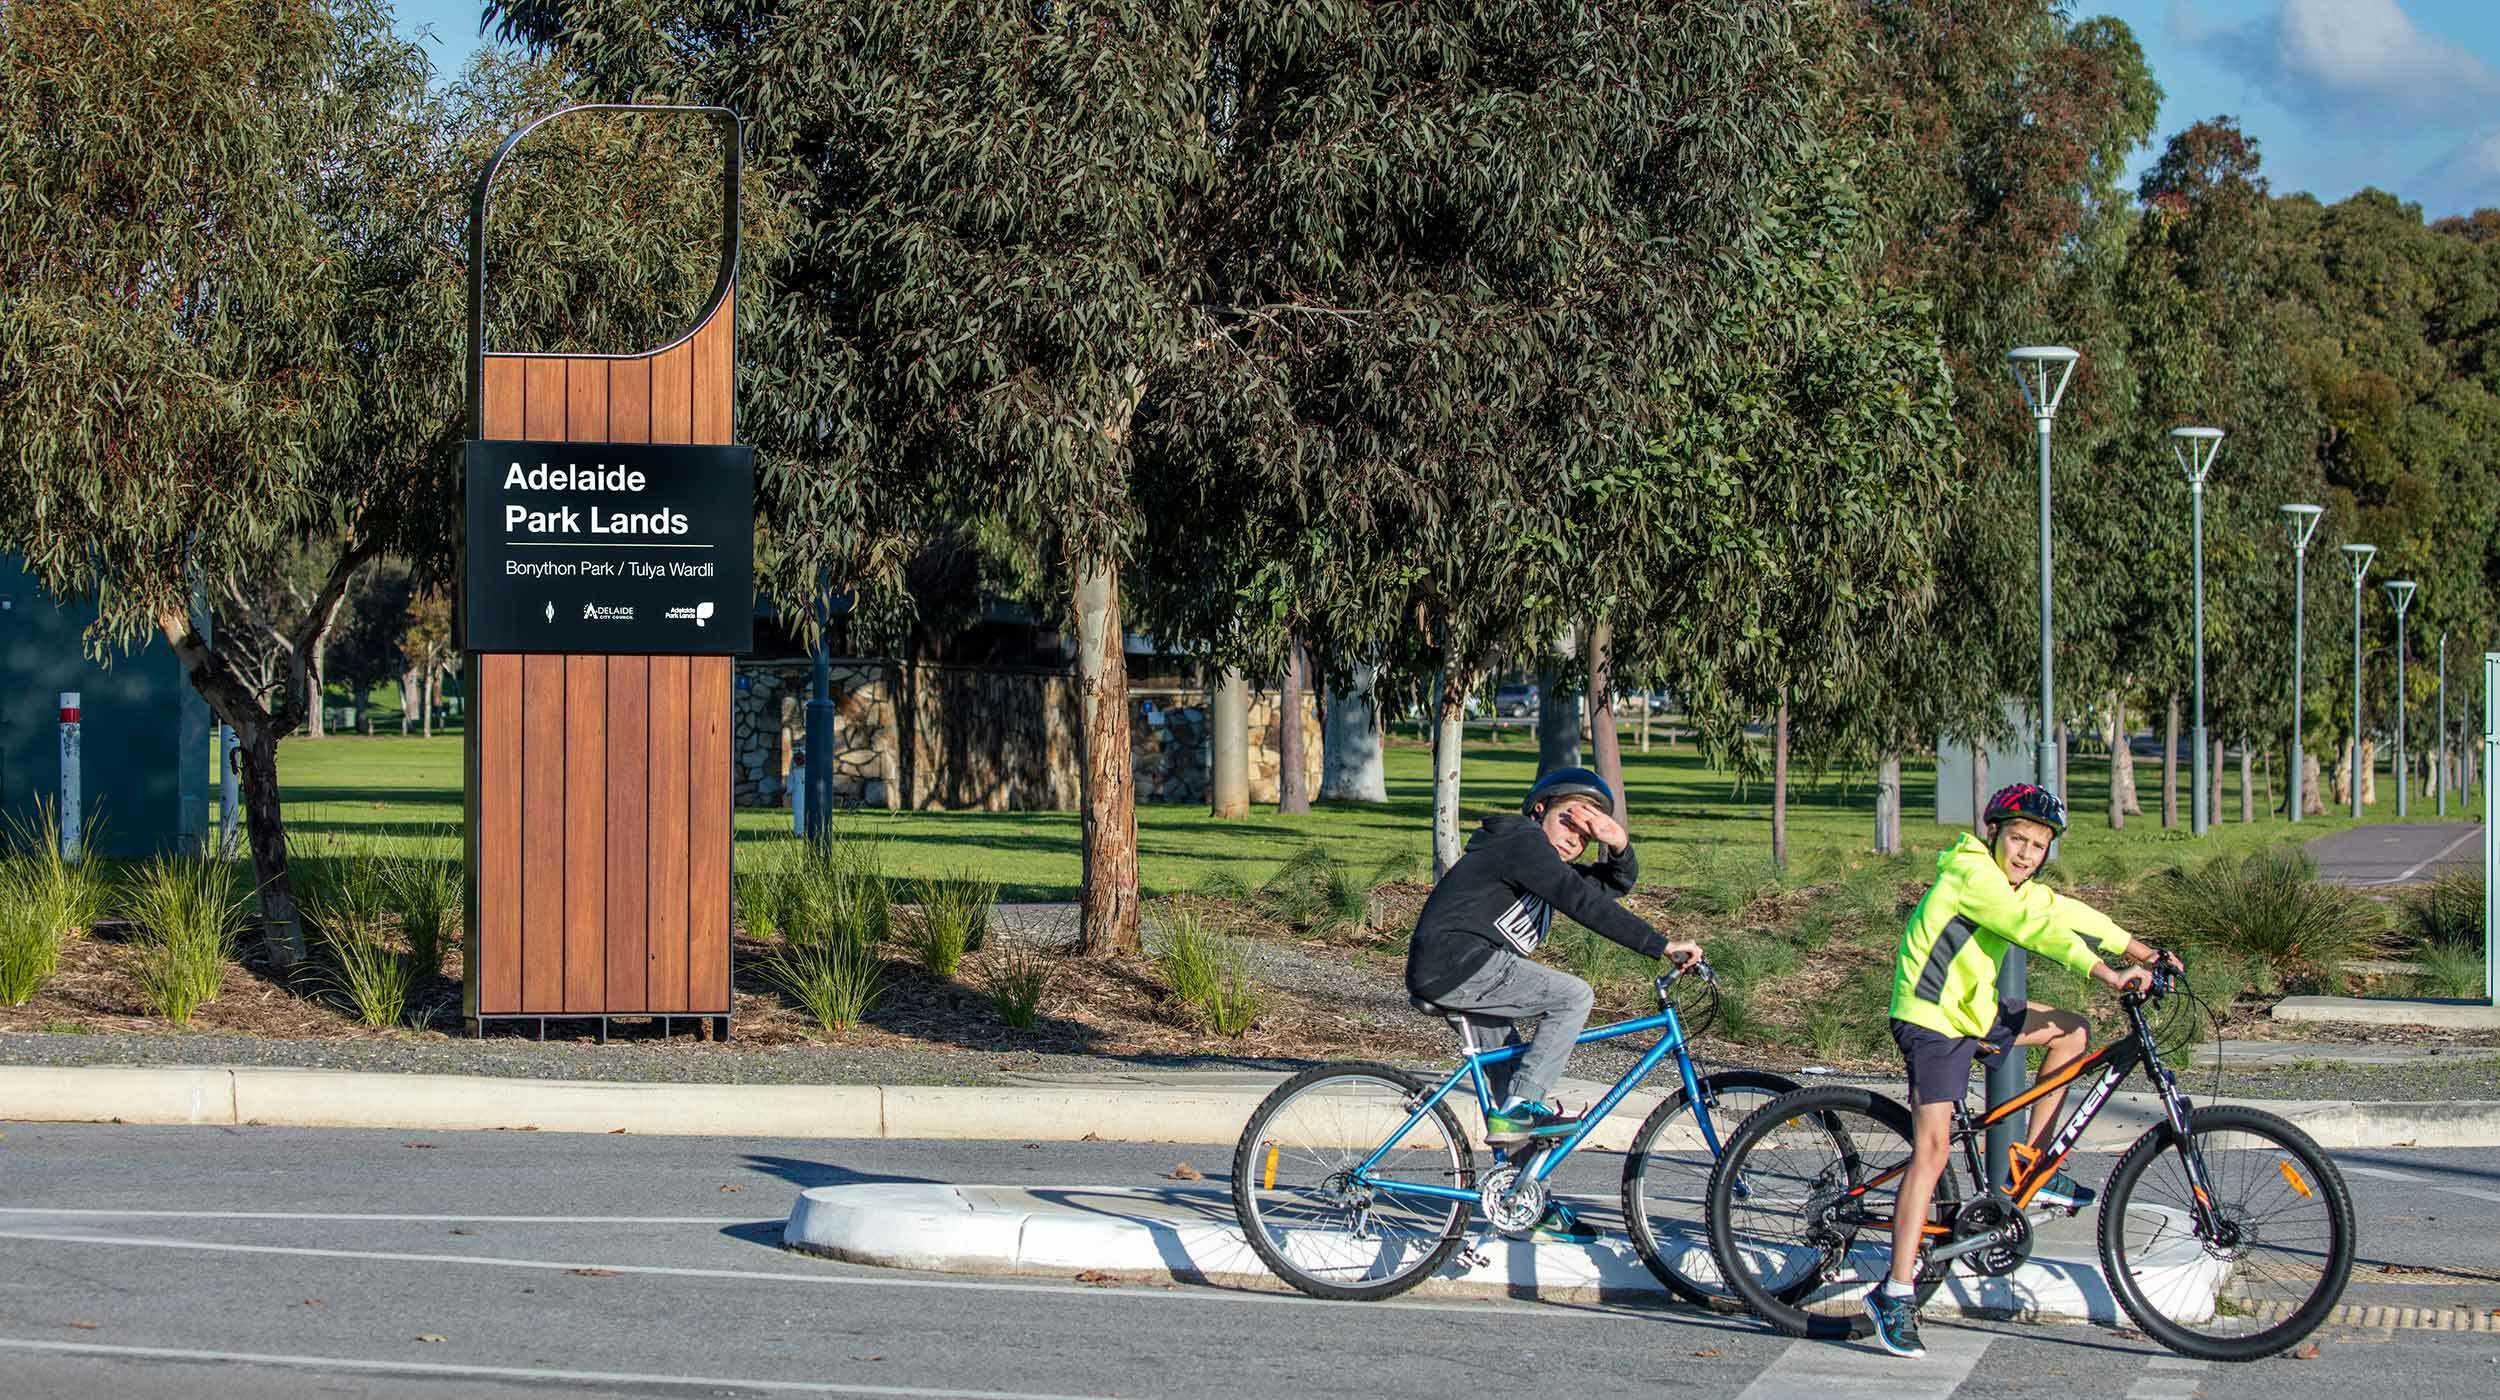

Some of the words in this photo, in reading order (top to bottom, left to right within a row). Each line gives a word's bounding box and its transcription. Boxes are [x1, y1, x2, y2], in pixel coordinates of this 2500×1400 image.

[503, 462, 646, 492] Adelaide
[505, 504, 581, 533] Park
[591, 506, 689, 535] Lands
[506, 560, 577, 579] Bonython
[580, 560, 615, 576] Park
[617, 560, 625, 576] /
[627, 561, 666, 580] Tulya
[668, 561, 714, 577] Wardli
[583, 602, 634, 620] ADELAIDE
[2047, 1063, 2121, 1156] TREK
